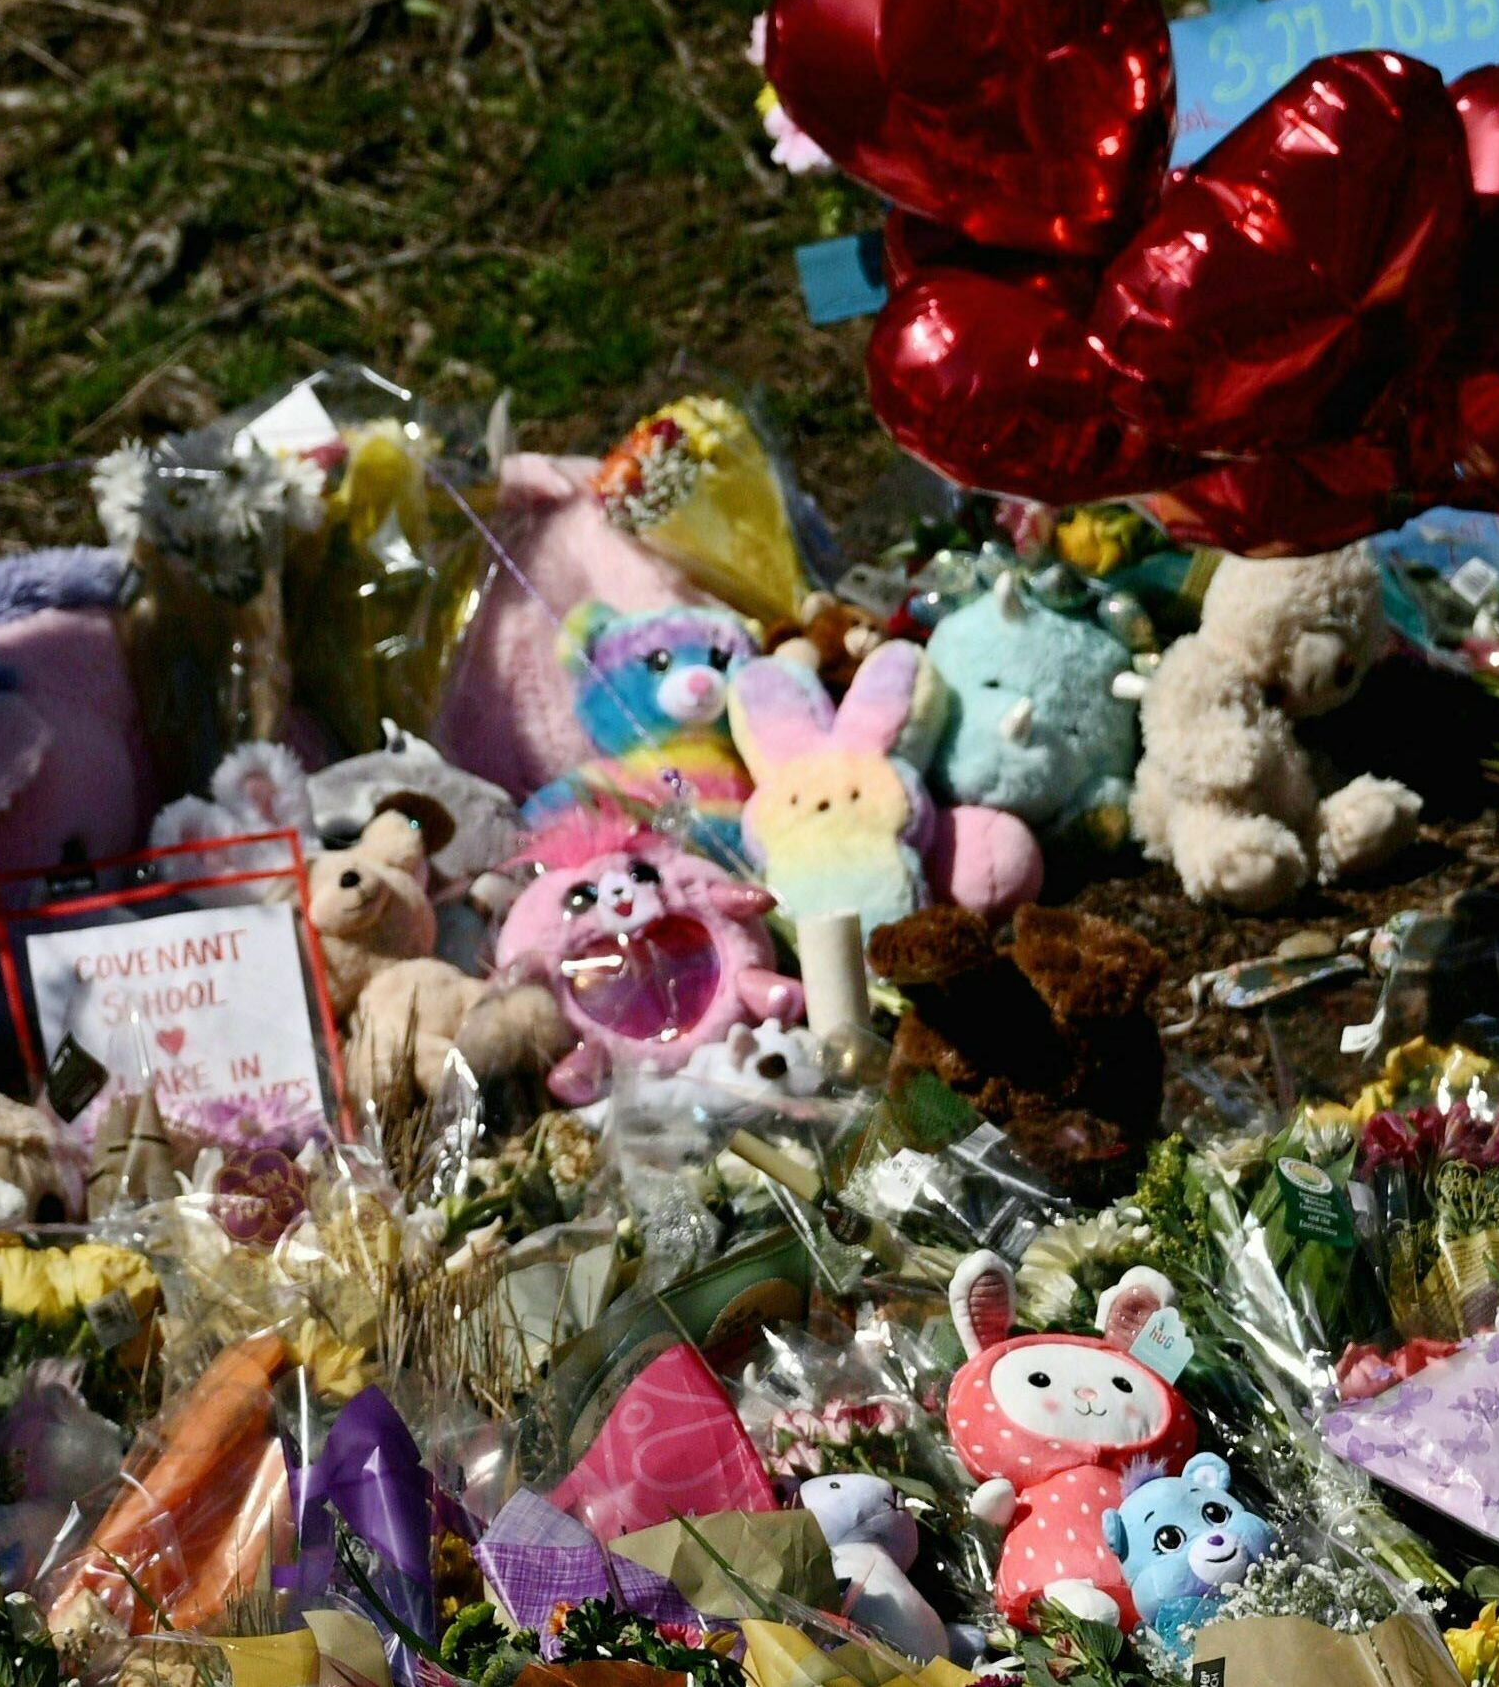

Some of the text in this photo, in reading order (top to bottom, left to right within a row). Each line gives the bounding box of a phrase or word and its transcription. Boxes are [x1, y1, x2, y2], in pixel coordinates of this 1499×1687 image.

[75, 929, 248, 983] COVENANT
[103, 978, 228, 1027] SCHOOL
[154, 1062, 212, 1095] ARE
[231, 1053, 262, 1082] IN
